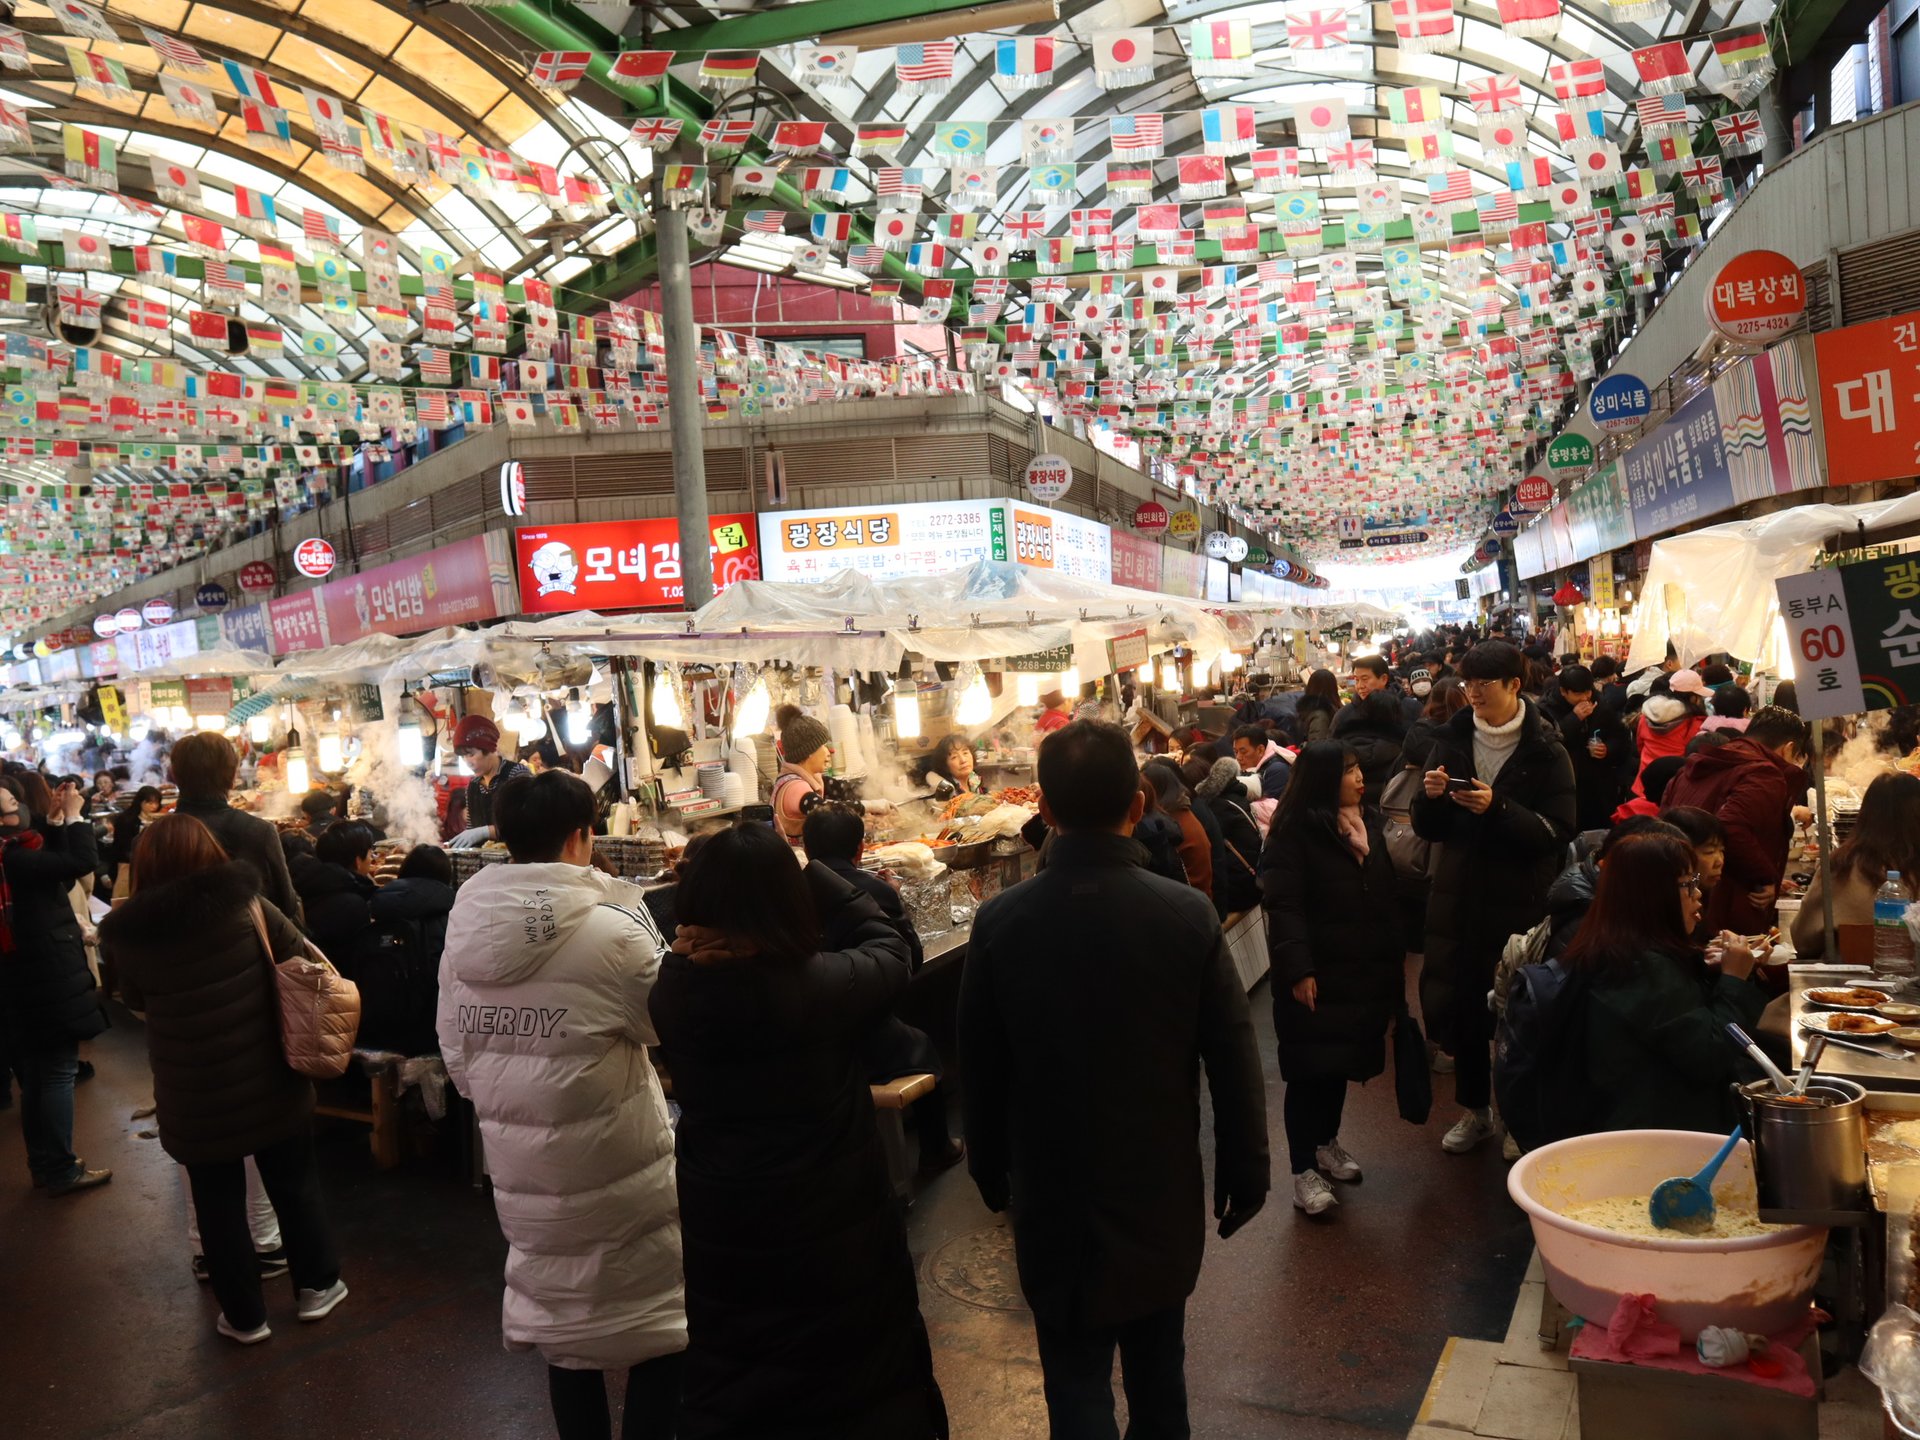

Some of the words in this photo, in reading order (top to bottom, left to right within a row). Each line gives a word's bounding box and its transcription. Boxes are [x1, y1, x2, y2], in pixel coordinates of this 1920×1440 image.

[1715, 273, 1799, 309] 대복상회
[1737, 317, 1790, 335] 2275-4324
[1892, 321, 1918, 353] 건
[1593, 389, 1646, 414] 성미식품
[1028, 469, 1067, 485] 광장식당
[1642, 428, 1693, 502] 성미식품
[1519, 482, 1549, 500] 신안상회
[929, 512, 982, 527] 2272-3385
[1135, 511, 1166, 524] 복민회집
[718, 526, 744, 549] 모녀
[788, 517, 891, 549] 광장식당
[1016, 520, 1052, 562] 광장식당
[299, 552, 334, 566] 모녀김밥
[894, 550, 937, 567] 아구찜
[945, 546, 988, 562] 아구탕
[1112, 547, 1156, 583] 복민회집
[371, 573, 425, 623] 모녀김밥
[1799, 624, 1846, 662] 60
[1017, 660, 1067, 672] 2268-6738
[1411, 671, 1430, 680] BOY
[1816, 667, 1842, 692] 호
[523, 898, 537, 911] IS
[535, 888, 557, 941] NERDY?
[525, 915, 538, 944] WHO
